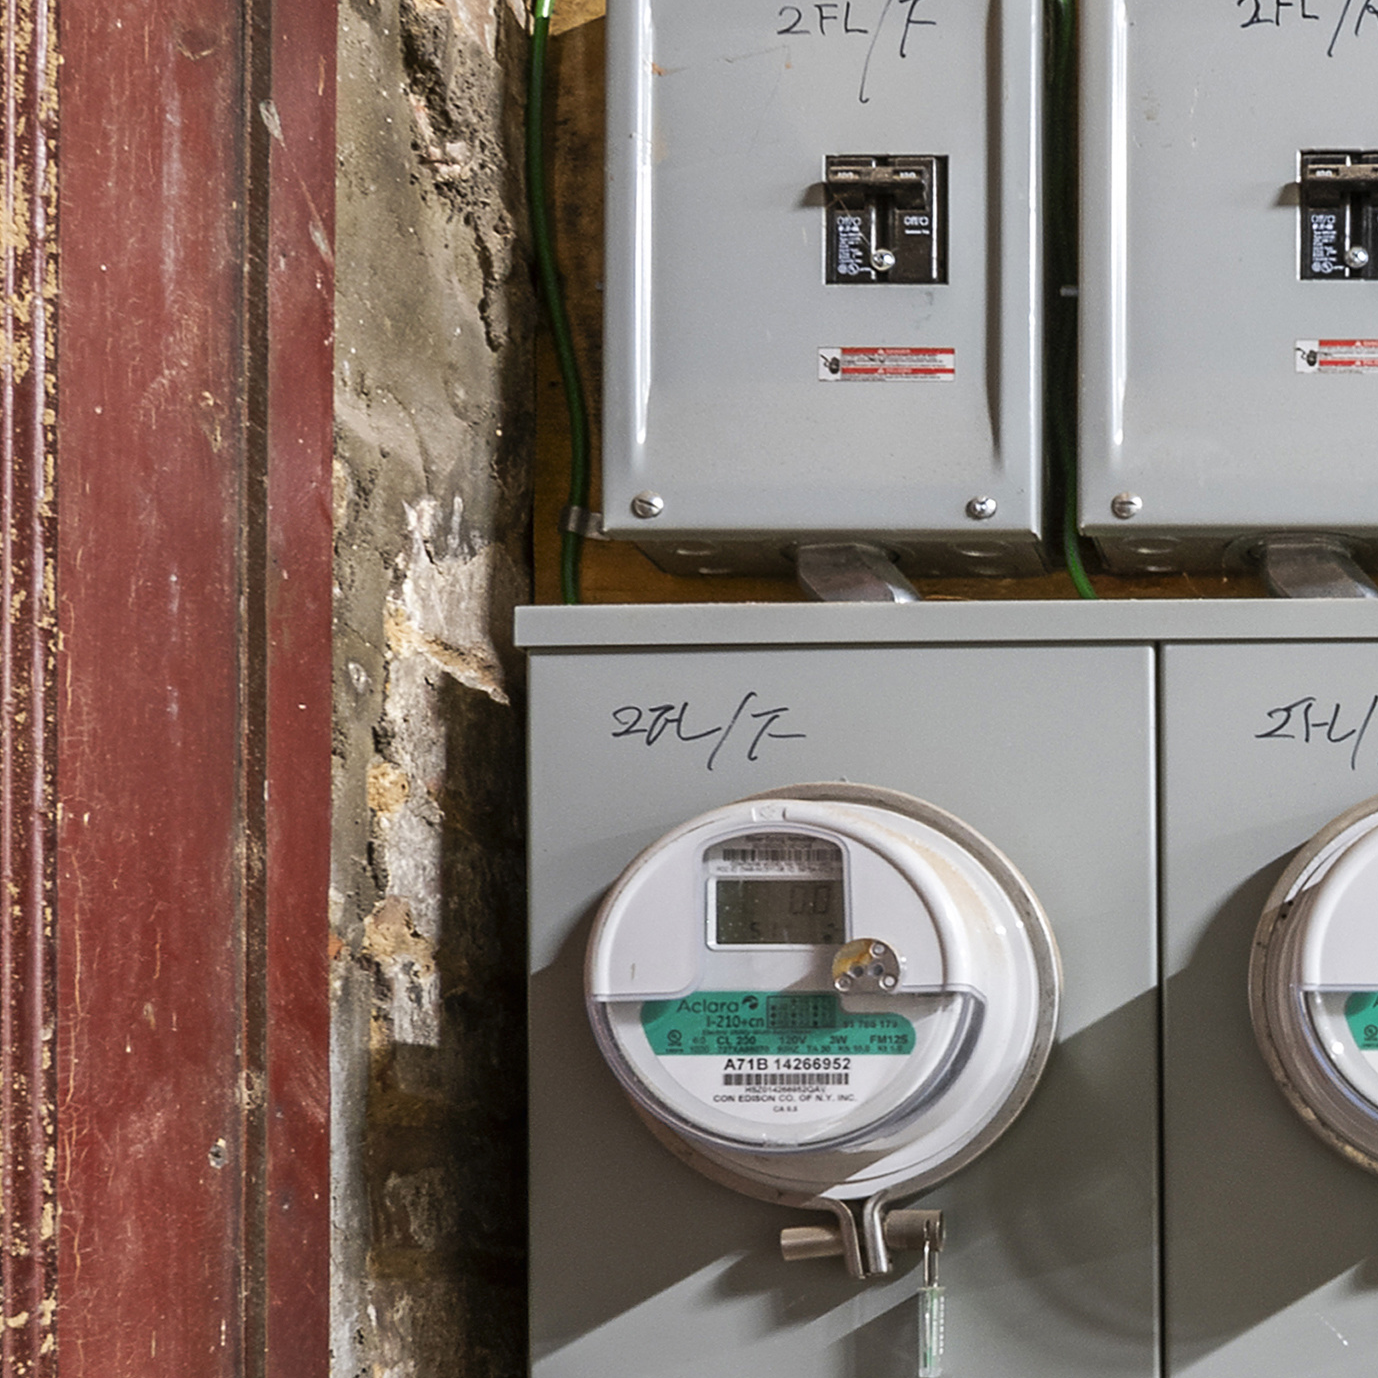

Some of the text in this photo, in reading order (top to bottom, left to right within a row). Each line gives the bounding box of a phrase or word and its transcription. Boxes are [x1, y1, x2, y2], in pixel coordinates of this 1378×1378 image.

[676, 998, 739, 1013] Aclara
[724, 1058, 851, 1071] A71B 14266952
[713, 1094, 735, 1102] CON
[738, 1094, 775, 1102] EDISON
[799, 1094, 811, 1102] OF
